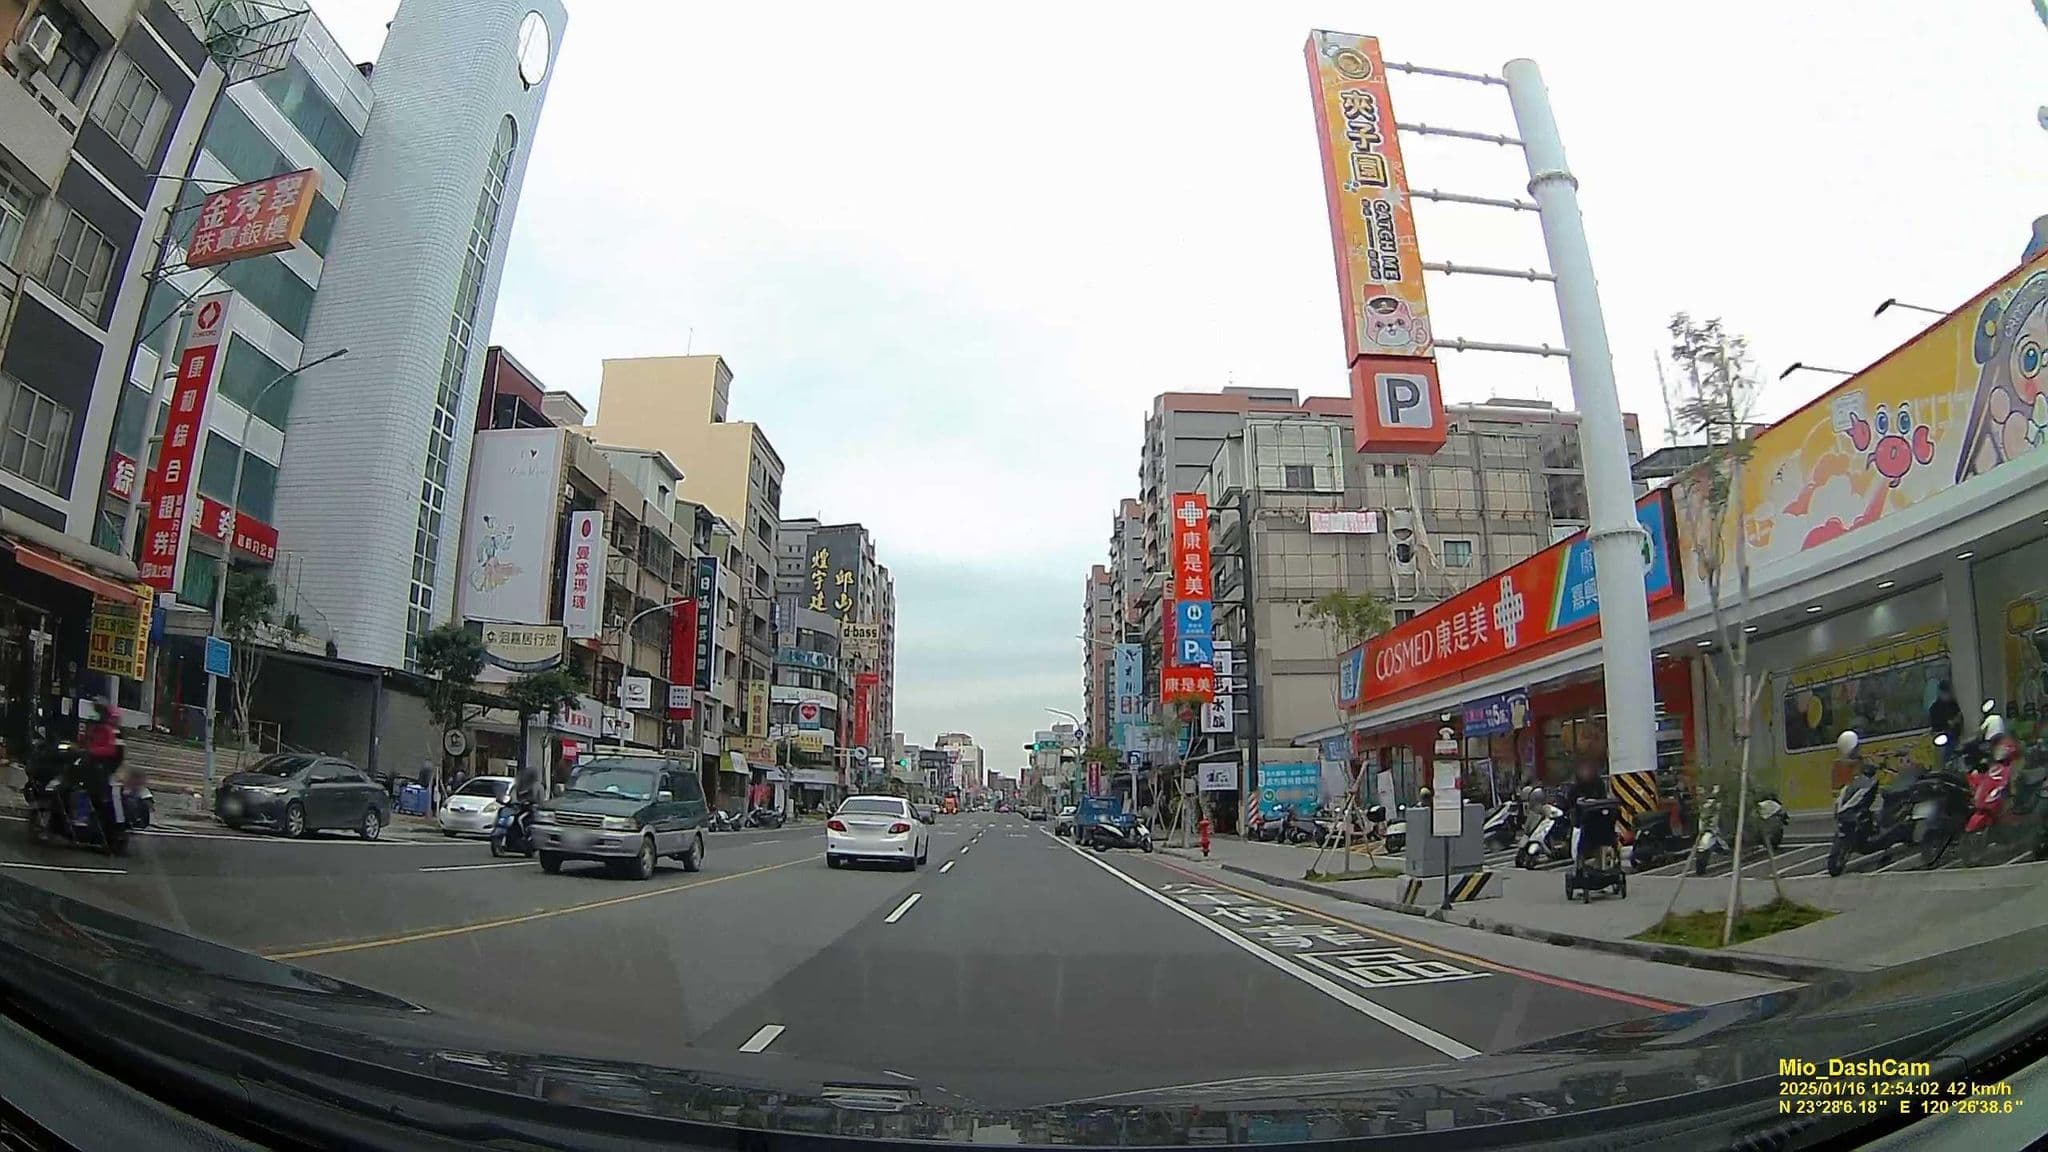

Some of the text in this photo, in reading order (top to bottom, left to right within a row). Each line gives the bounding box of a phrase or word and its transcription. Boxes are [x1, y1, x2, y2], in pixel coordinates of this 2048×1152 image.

[192, 215, 290, 256] 珠寶銀樓
[1373, 200, 1400, 281] CATCH ME
[1386, 378, 1420, 423] P
[154, 356, 205, 556] 康和綜合證券
[1182, 532, 1203, 596] 康是美
[1185, 640, 1199, 660] P
[1376, 630, 1433, 681] COSMED
[1436, 602, 1488, 659] 康是美
[1165, 678, 1211, 693] 康是美
